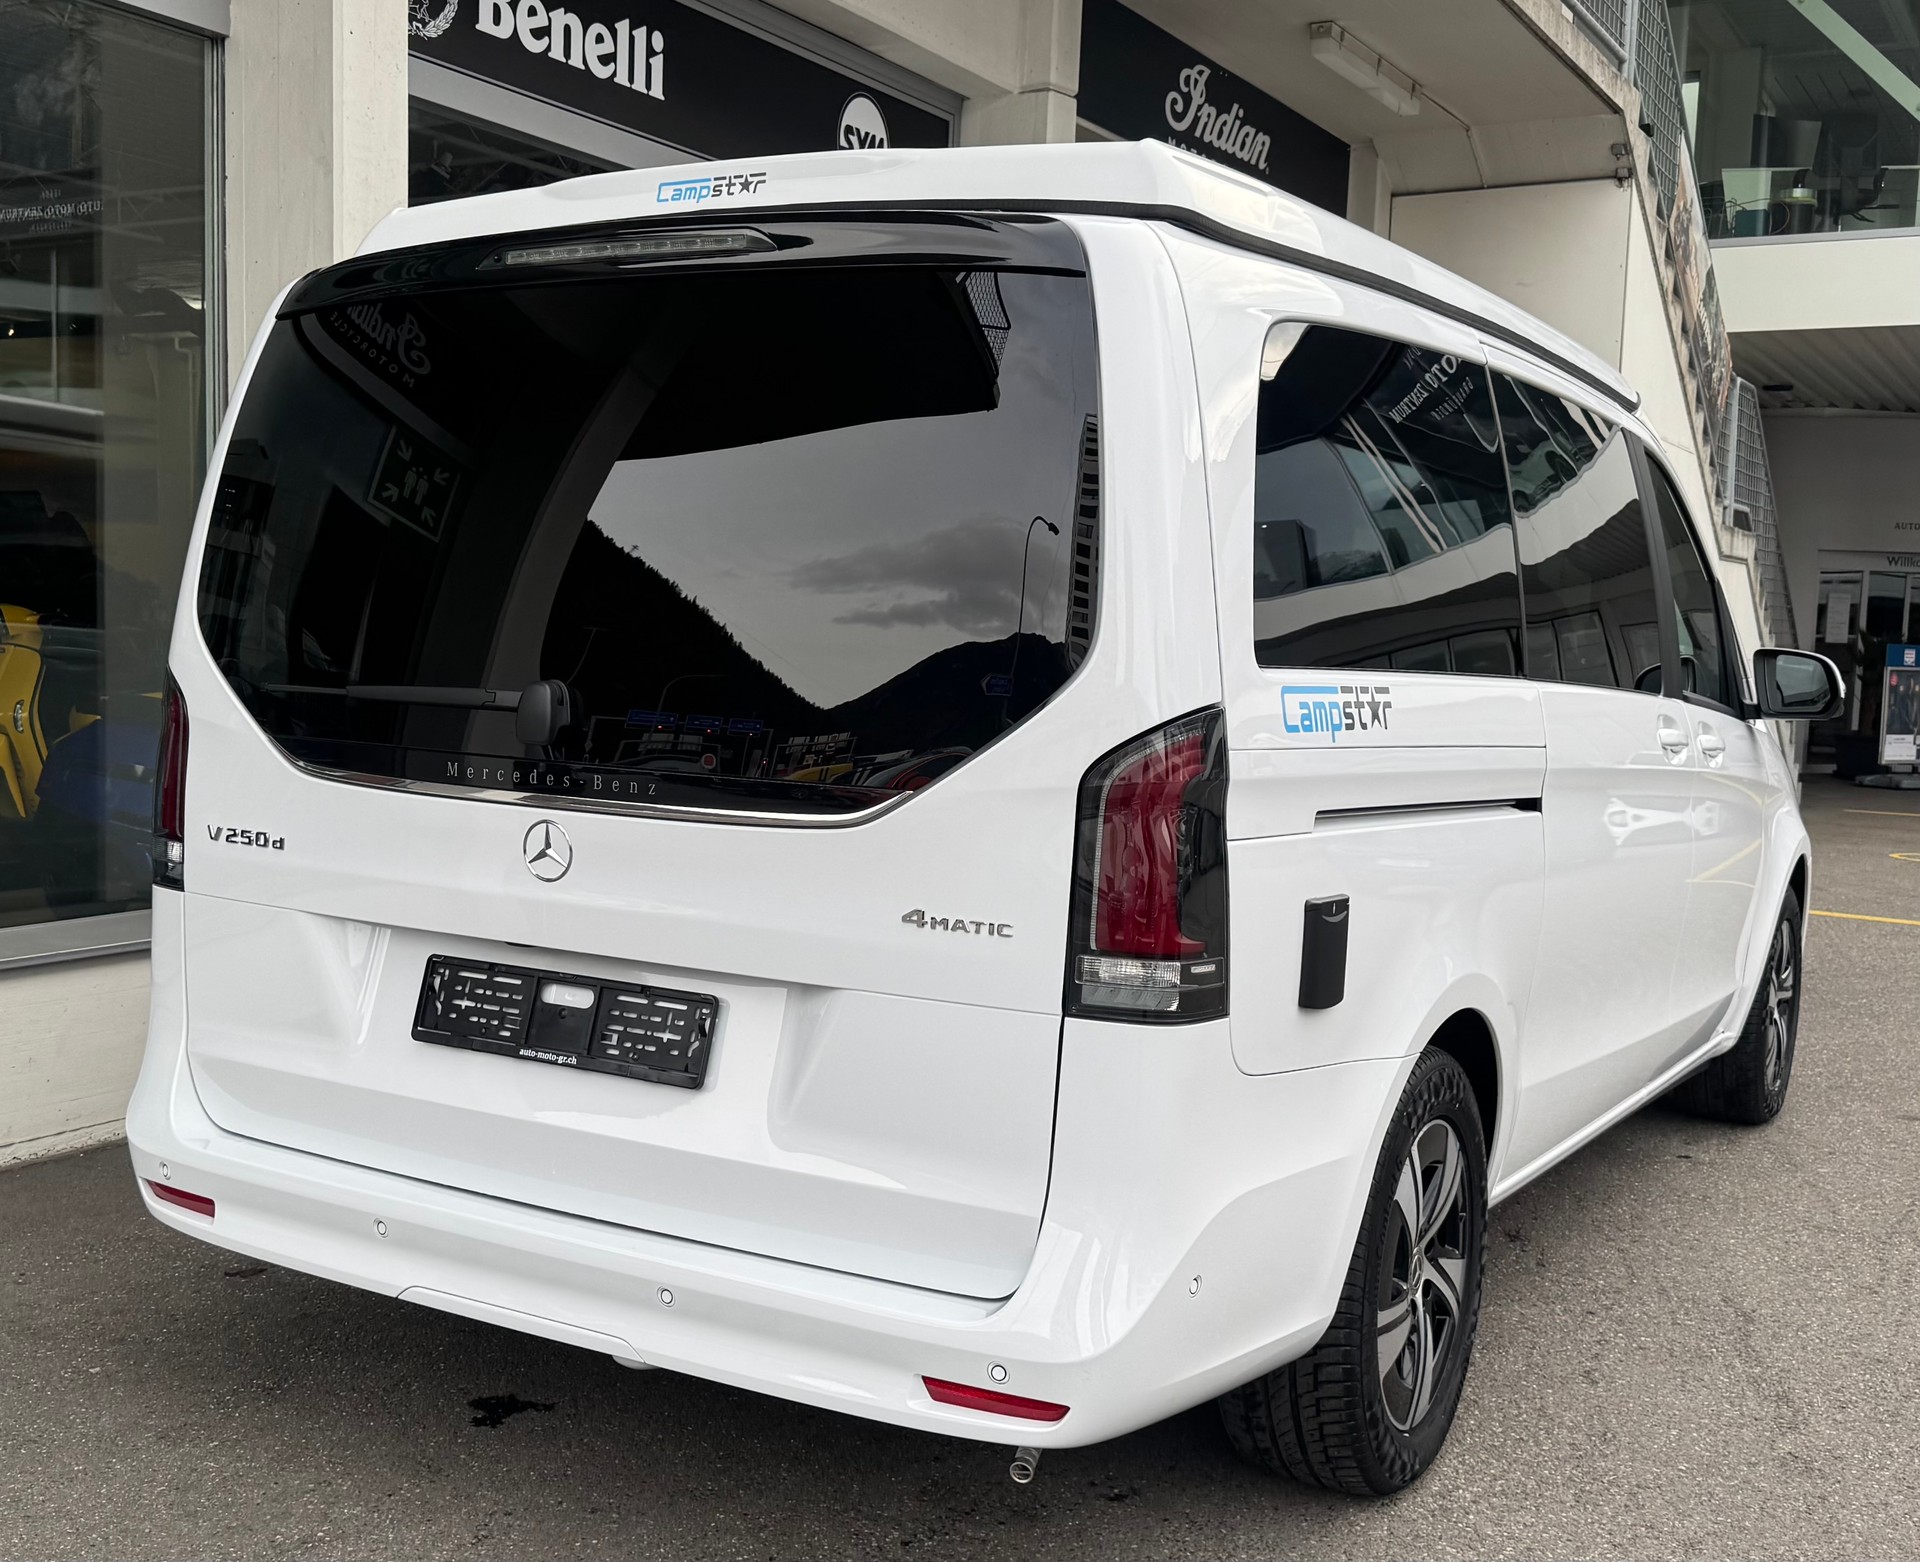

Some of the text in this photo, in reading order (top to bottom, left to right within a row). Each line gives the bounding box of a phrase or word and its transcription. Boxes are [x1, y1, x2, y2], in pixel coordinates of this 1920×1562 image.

[1165, 64, 1271, 170] Indian
[447, 761, 656, 795] Mercedes-Benz
[901, 908, 1014, 938] 4MATIC
